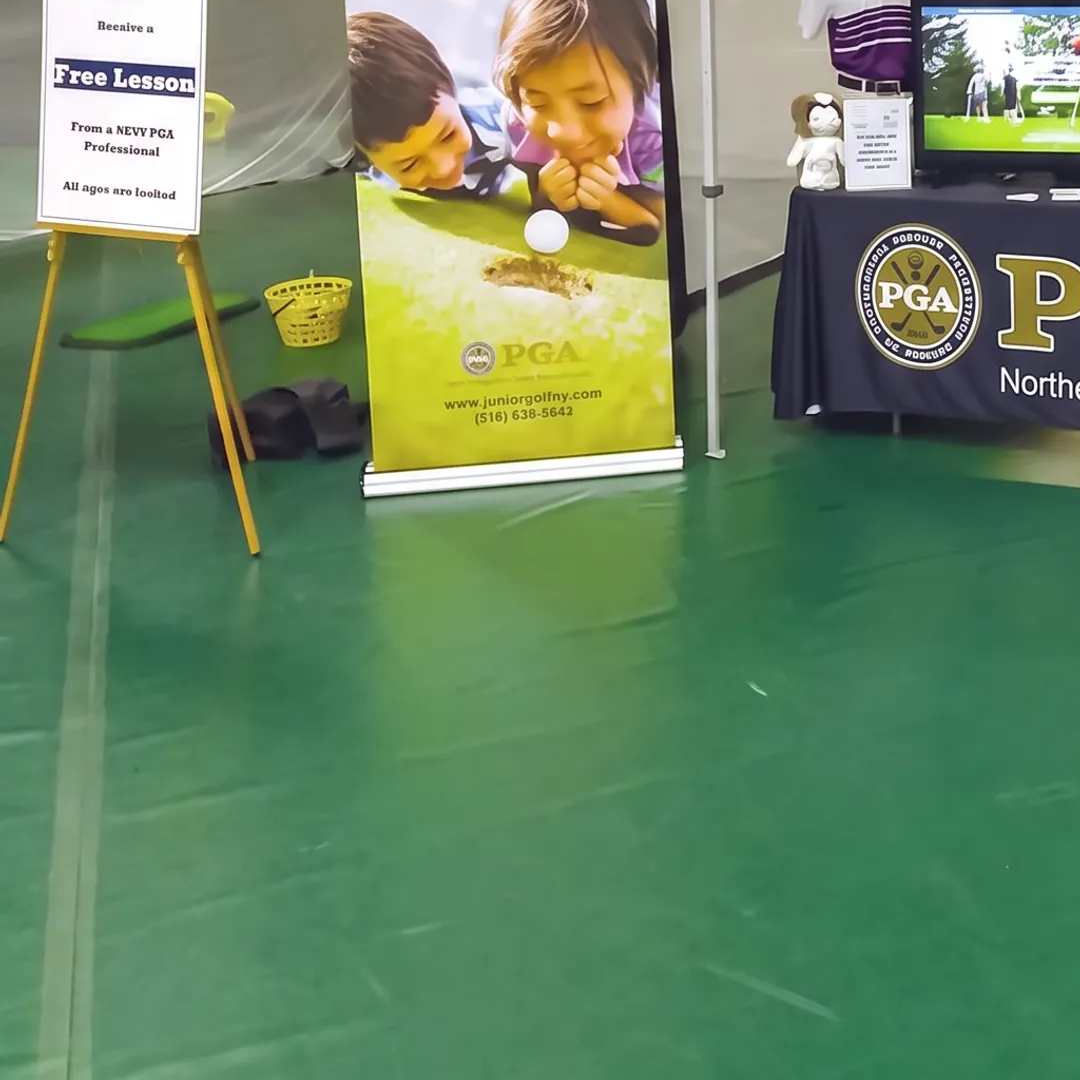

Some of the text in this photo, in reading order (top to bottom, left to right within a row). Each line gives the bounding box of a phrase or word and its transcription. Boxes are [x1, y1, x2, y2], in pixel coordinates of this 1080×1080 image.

[147, 25, 154, 33] a
[54, 63, 195, 94] Free Lesson
[71, 121, 102, 134] From
[106, 126, 113, 134] a
[149, 127, 174, 139] PGA
[84, 141, 160, 157] Professional
[878, 282, 958, 313] PGA
[502, 340, 584, 367] PGA
[444, 388, 602, 411] www.juniorgolfny.com
[474, 406, 574, 426] (516) 638-5642
